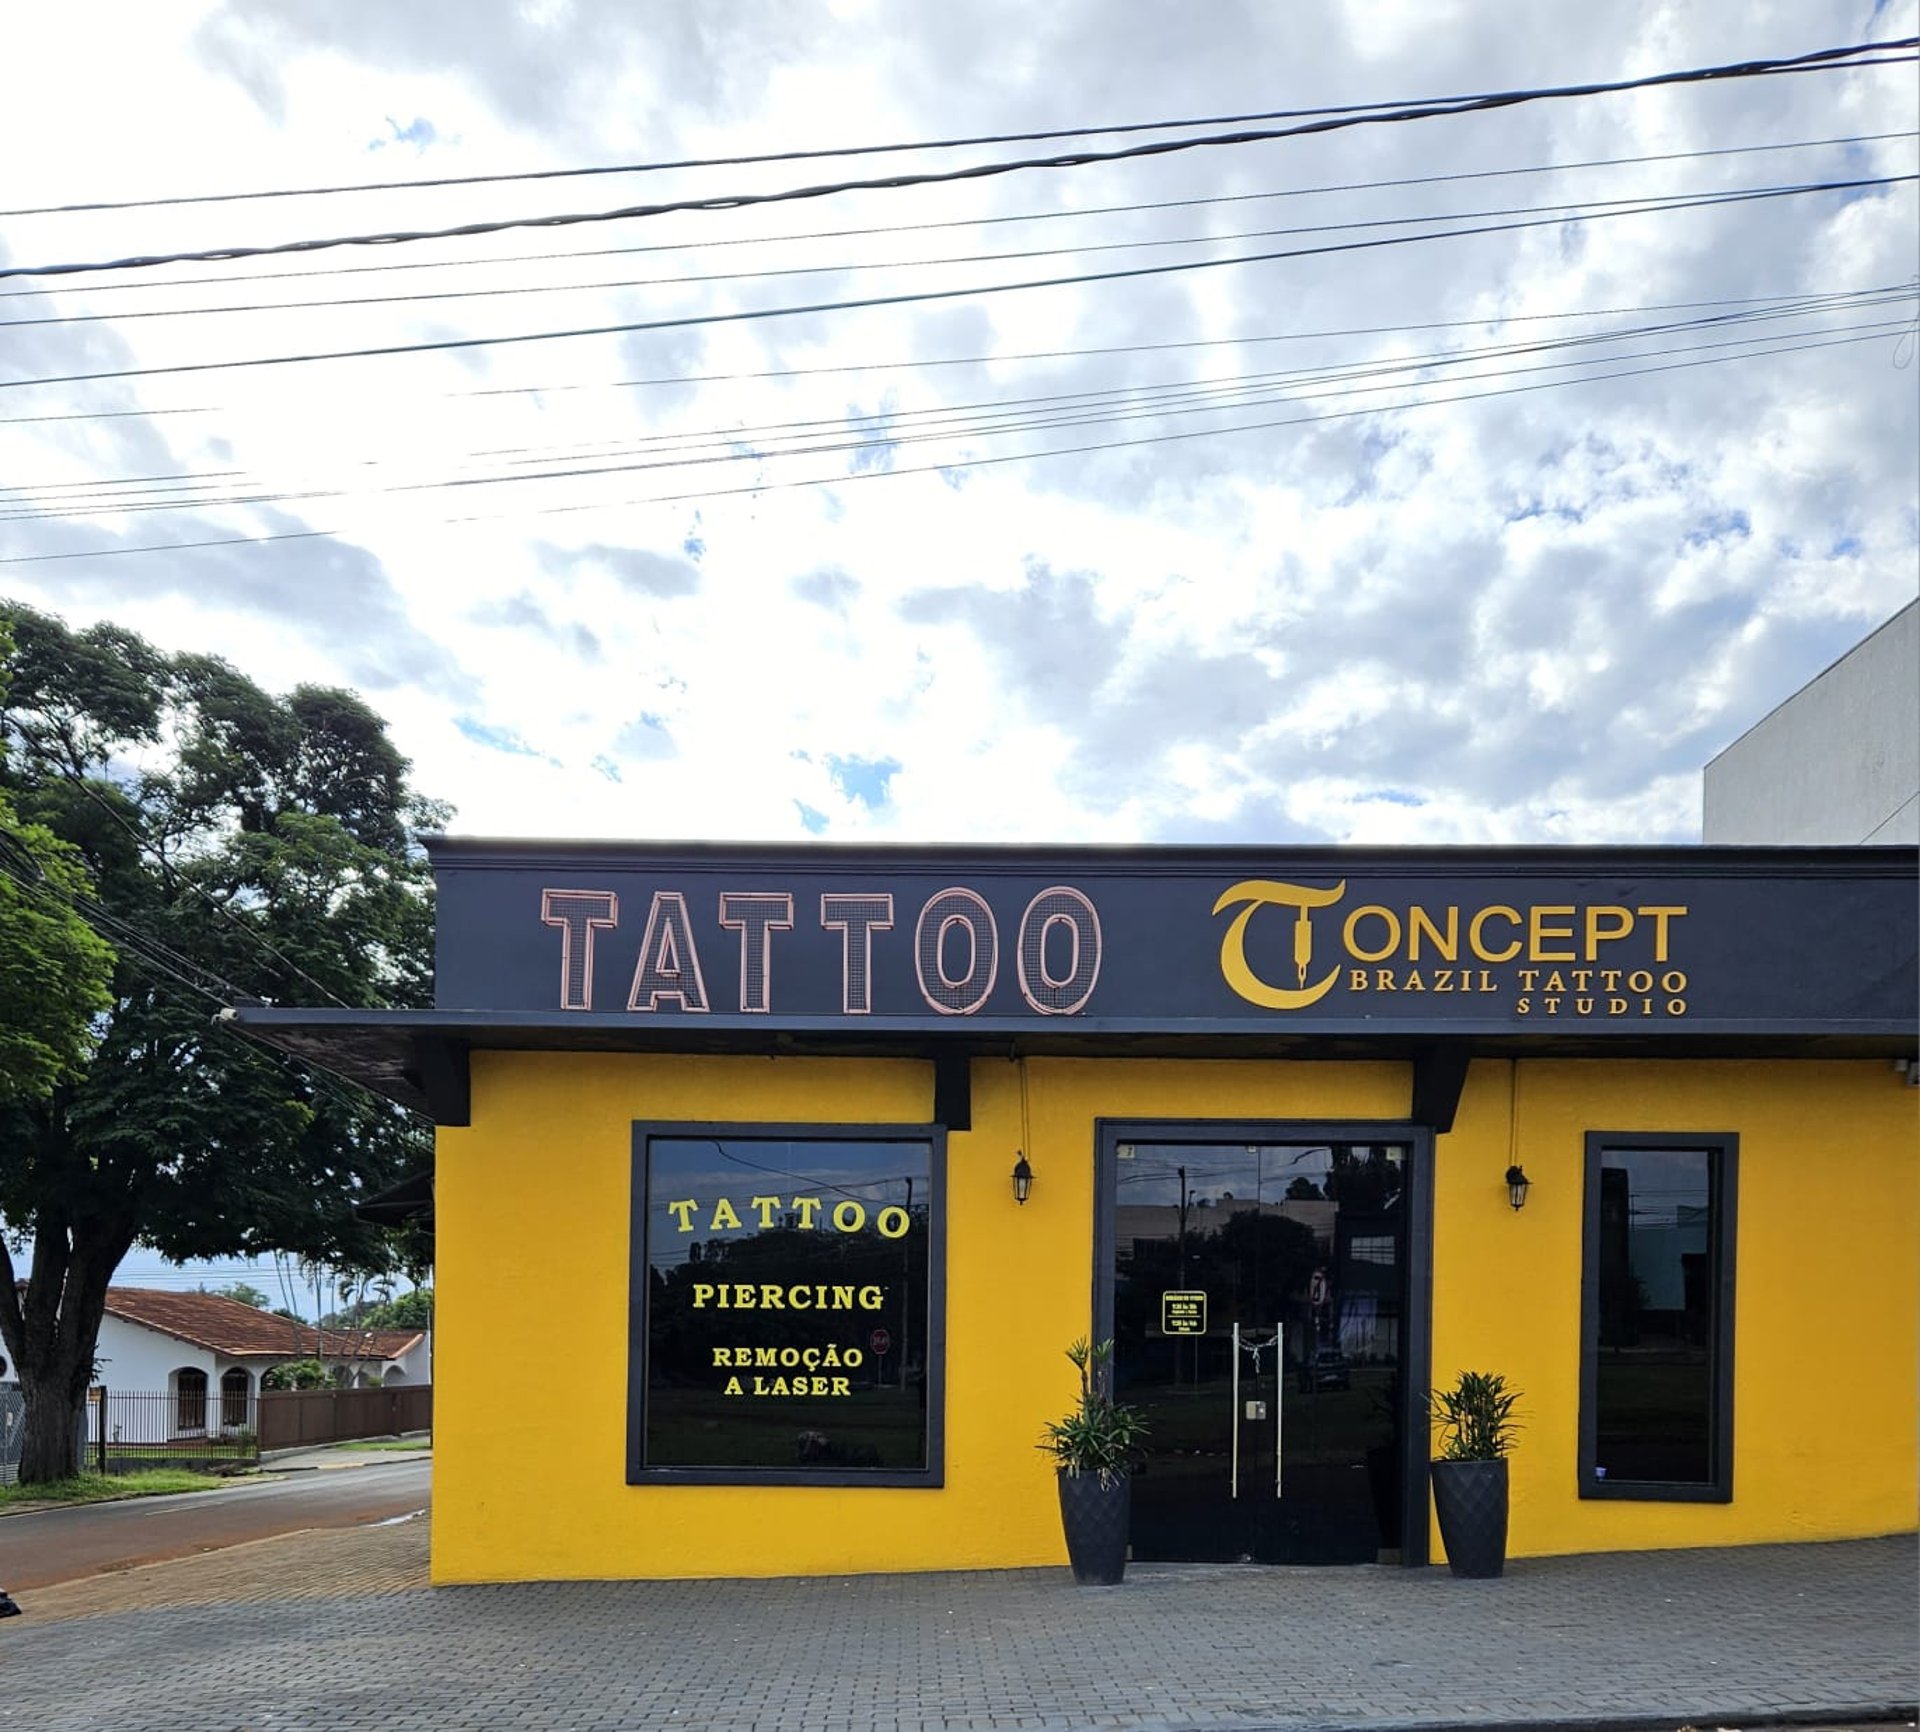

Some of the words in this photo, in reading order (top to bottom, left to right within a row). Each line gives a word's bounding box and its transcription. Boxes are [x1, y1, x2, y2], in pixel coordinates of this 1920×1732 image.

[540, 885, 1103, 1017] TATTOO
[1349, 969, 1498, 992] BRAZIL
[1518, 969, 1688, 993] TATTOO
[1516, 998, 1687, 1015] STUDIO
[668, 1196, 911, 1239] TATTOO
[692, 1284, 885, 1311] PIERCING
[712, 1344, 863, 1372] REMOÇÃO
[724, 1377, 743, 1396] A
[754, 1377, 851, 1396] LASER
